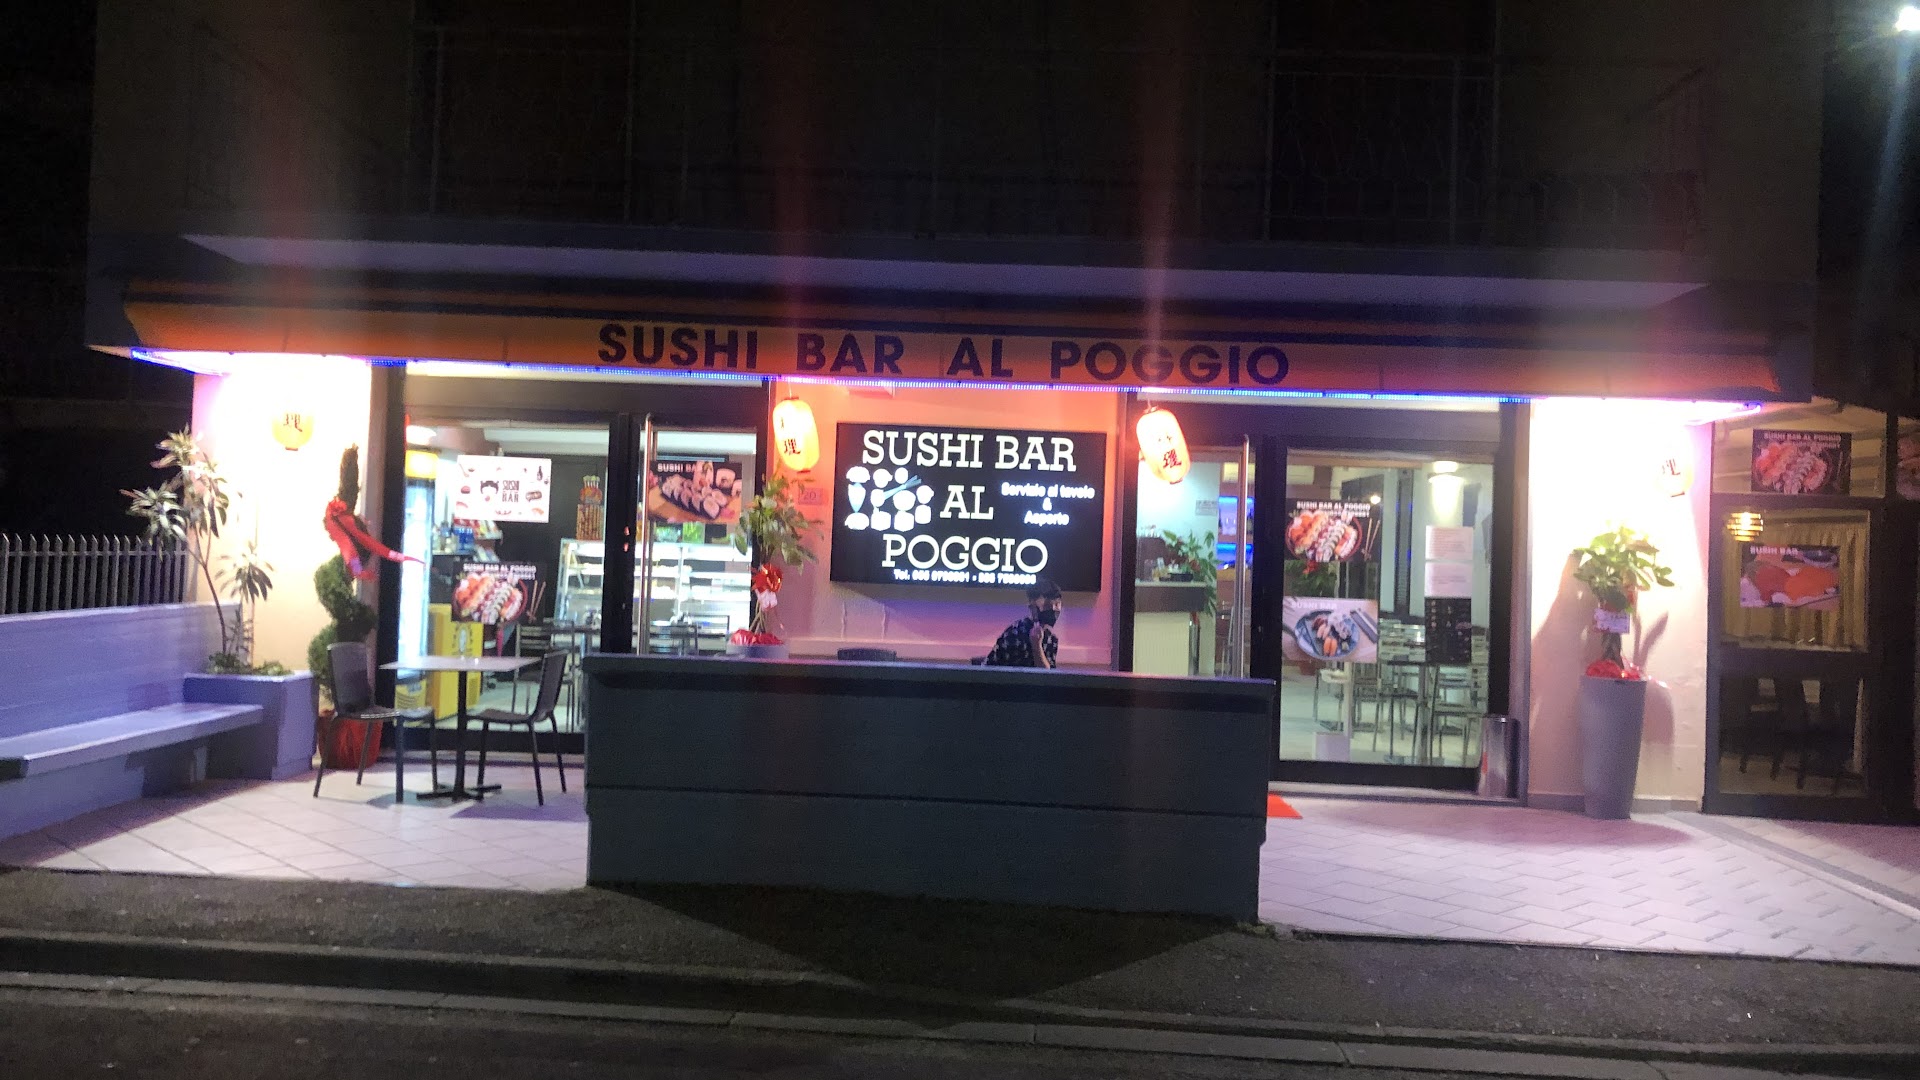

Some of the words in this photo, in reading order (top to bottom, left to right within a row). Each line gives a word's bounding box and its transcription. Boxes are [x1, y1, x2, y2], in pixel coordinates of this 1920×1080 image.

[598, 323, 758, 370] SUSHI
[796, 332, 904, 375] BAR
[946, 336, 1013, 378] AL
[1050, 340, 1289, 386] POGGIO
[862, 429, 984, 469] SUSHI
[995, 435, 1076, 472] BAR
[657, 463, 684, 473] SUSHI
[502, 491, 519, 503] BAR
[940, 485, 994, 520] AL
[1296, 501, 1317, 510] SUSHI
[1318, 502, 1333, 510] BAR
[881, 533, 1049, 573] POGGIO
[484, 564, 499, 572] BAR
